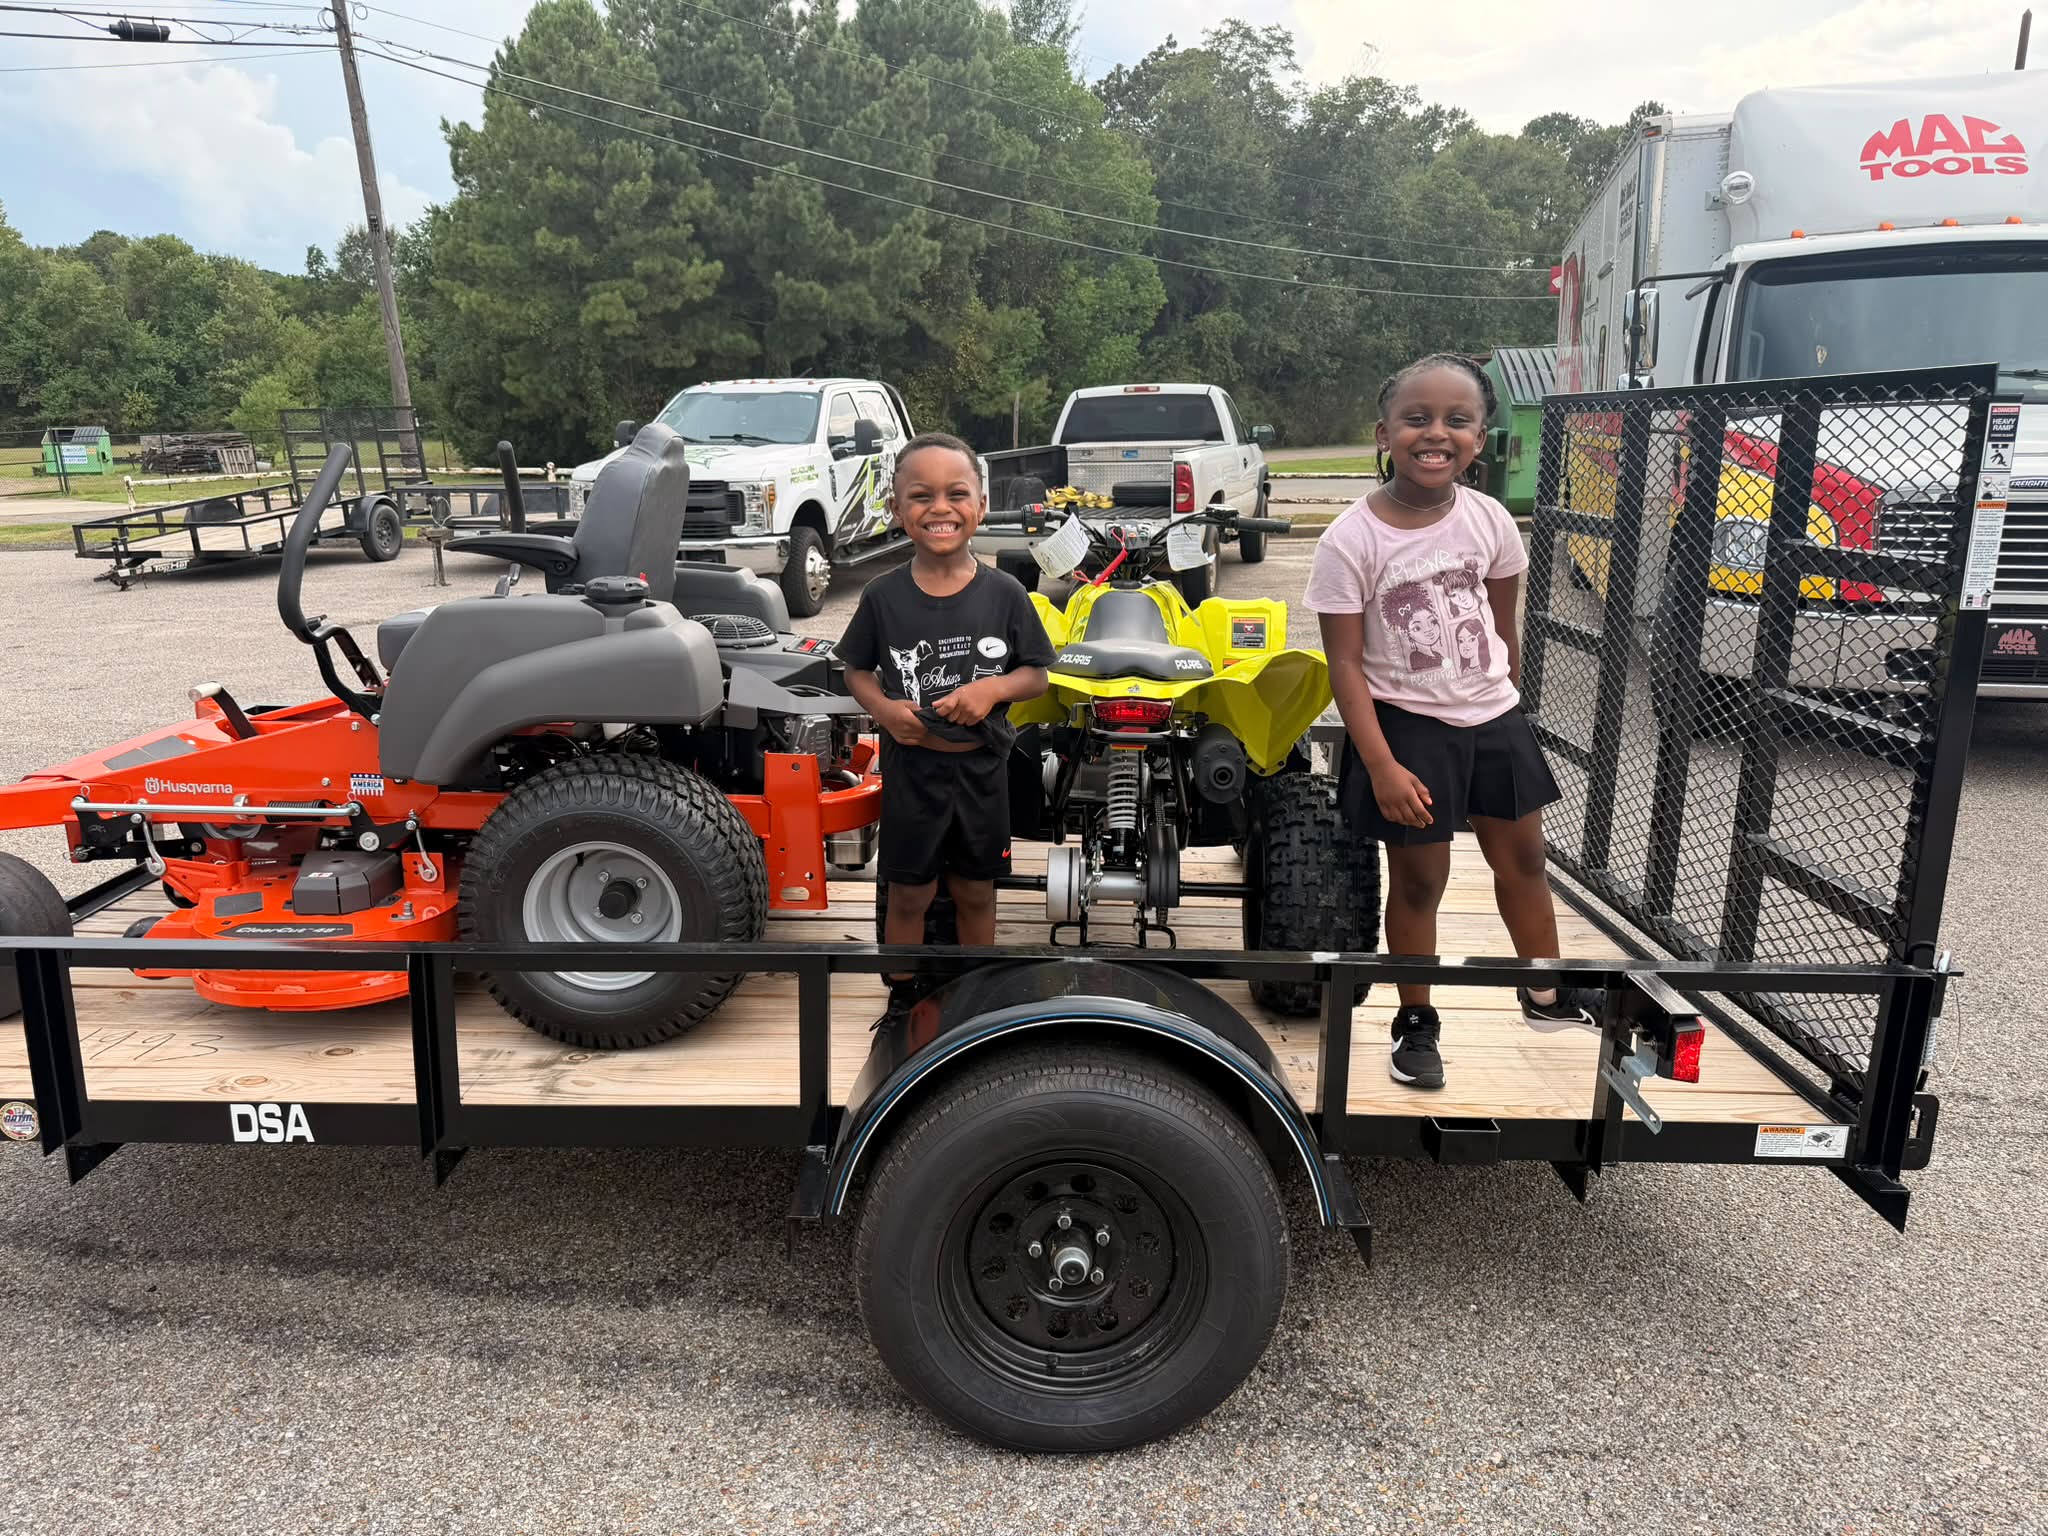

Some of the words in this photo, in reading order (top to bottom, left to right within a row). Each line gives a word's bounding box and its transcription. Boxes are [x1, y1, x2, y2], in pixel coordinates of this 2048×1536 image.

[1860, 114, 2026, 161] MAC
[1860, 157, 2029, 181] TOOLS
[1416, 549, 1454, 577] PWR
[952, 642, 971, 650] EXACT
[1998, 628, 2037, 646] MAC
[1058, 653, 1093, 666] POLARIS
[1174, 659, 1204, 671] POLARIS
[160, 779, 233, 794] Husqvarna
[230, 1103, 315, 1143] DSA
